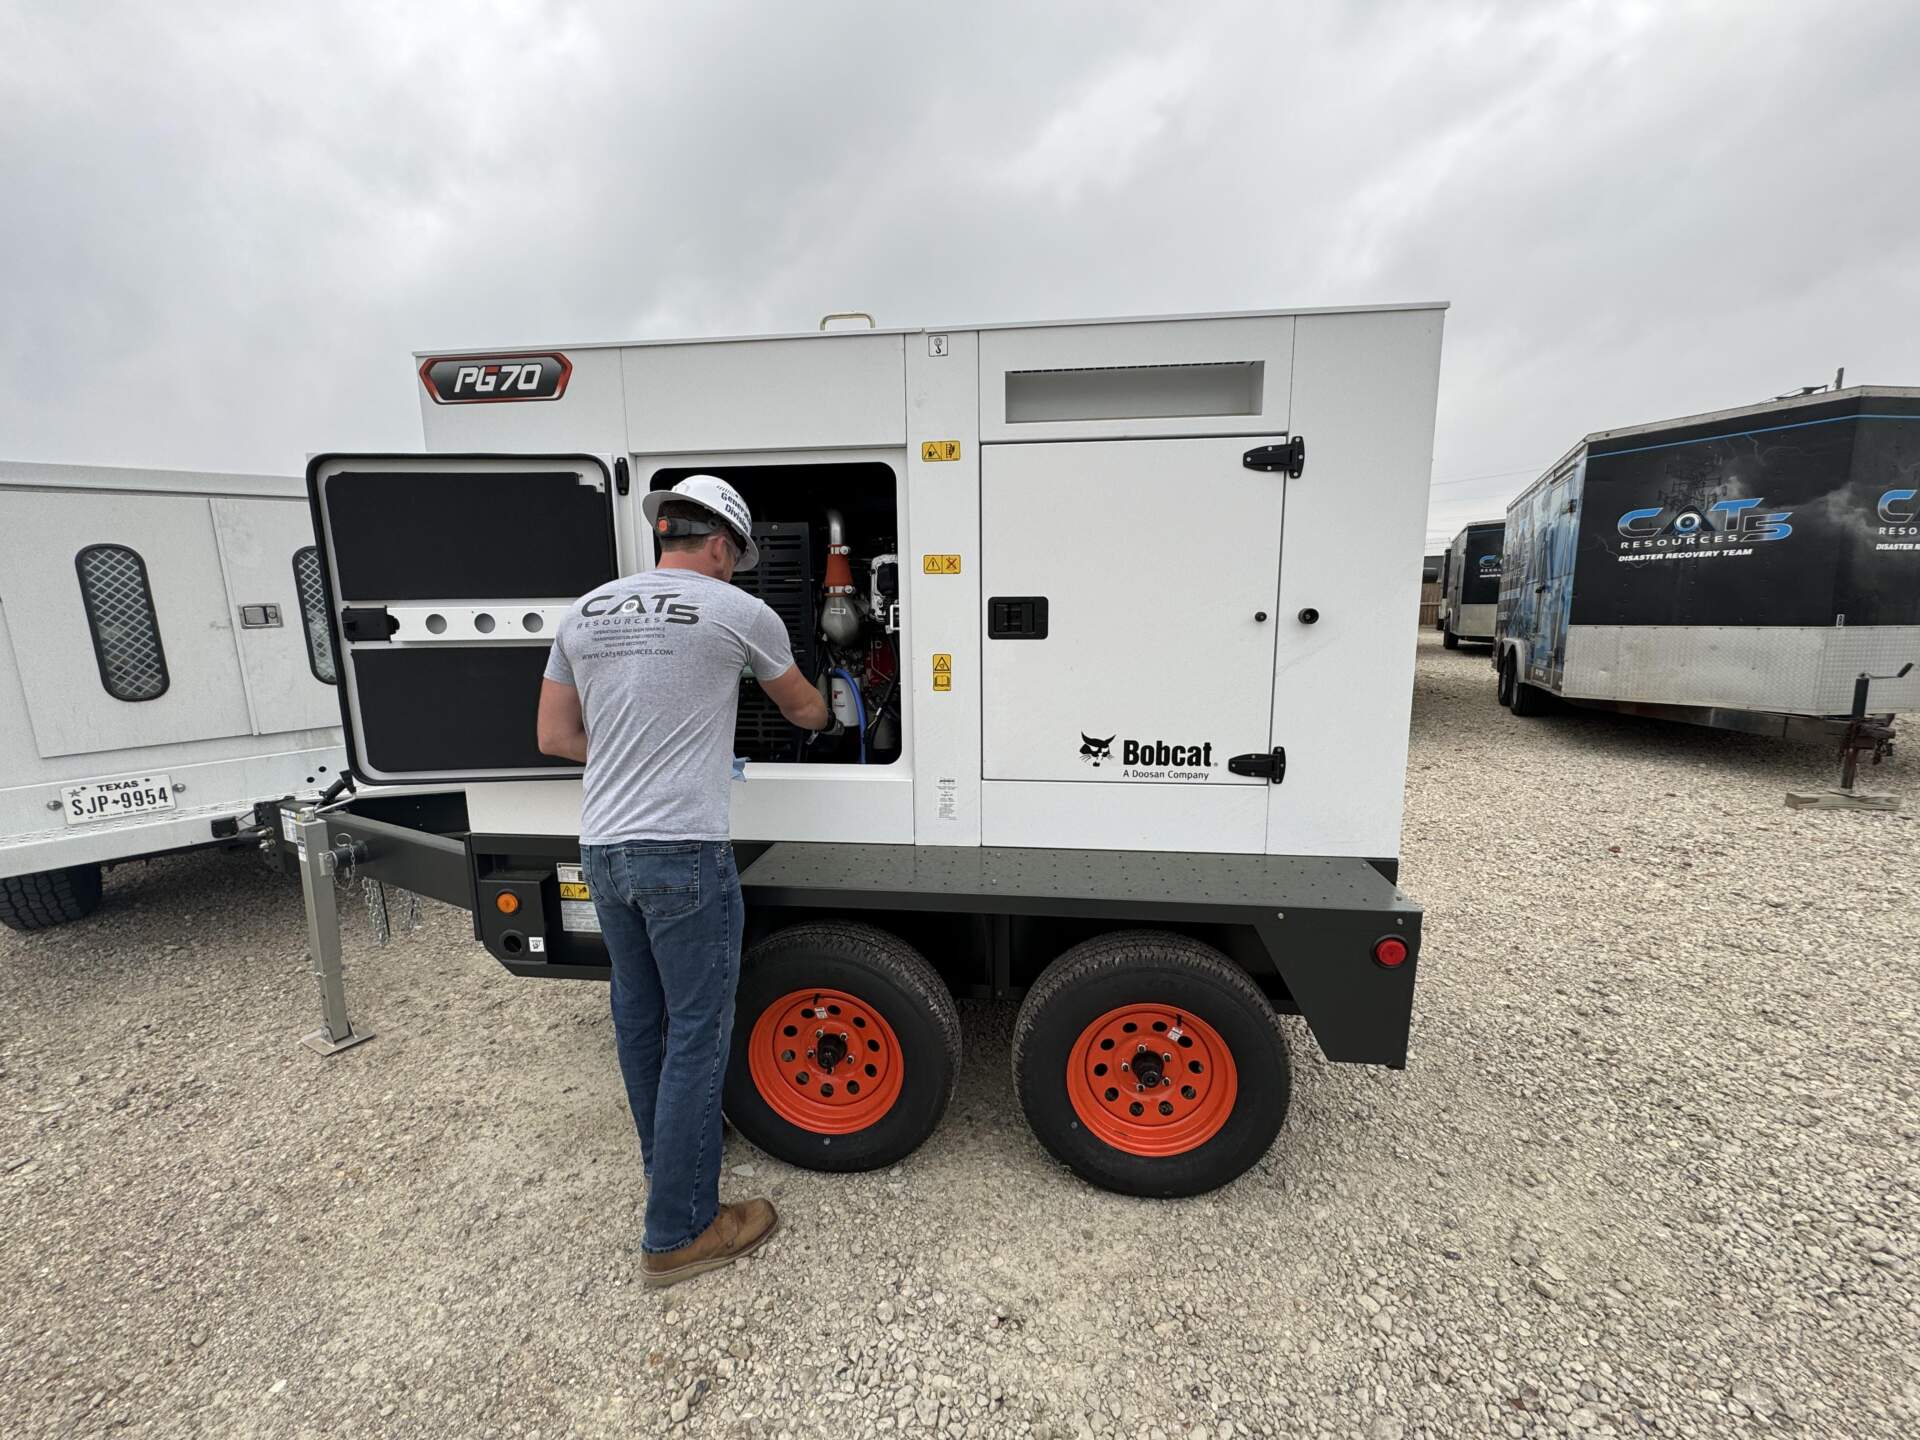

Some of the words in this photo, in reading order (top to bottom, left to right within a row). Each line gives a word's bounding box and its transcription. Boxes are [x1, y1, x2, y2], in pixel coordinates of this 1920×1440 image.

[453, 363, 544, 393] PG70
[1620, 534, 1738, 549] RESOURCES
[1618, 553, 1664, 562] DISASTER
[1665, 550, 1721, 559] RECOVERY
[1722, 548, 1753, 557] TEAM
[577, 617, 661, 630] RESOURCES
[1123, 740, 1212, 767] Bobcat
[1123, 769, 1130, 778] A
[1132, 769, 1165, 778] Doosan
[1167, 770, 1210, 781] Company
[97, 780, 139, 792] TEXAS
